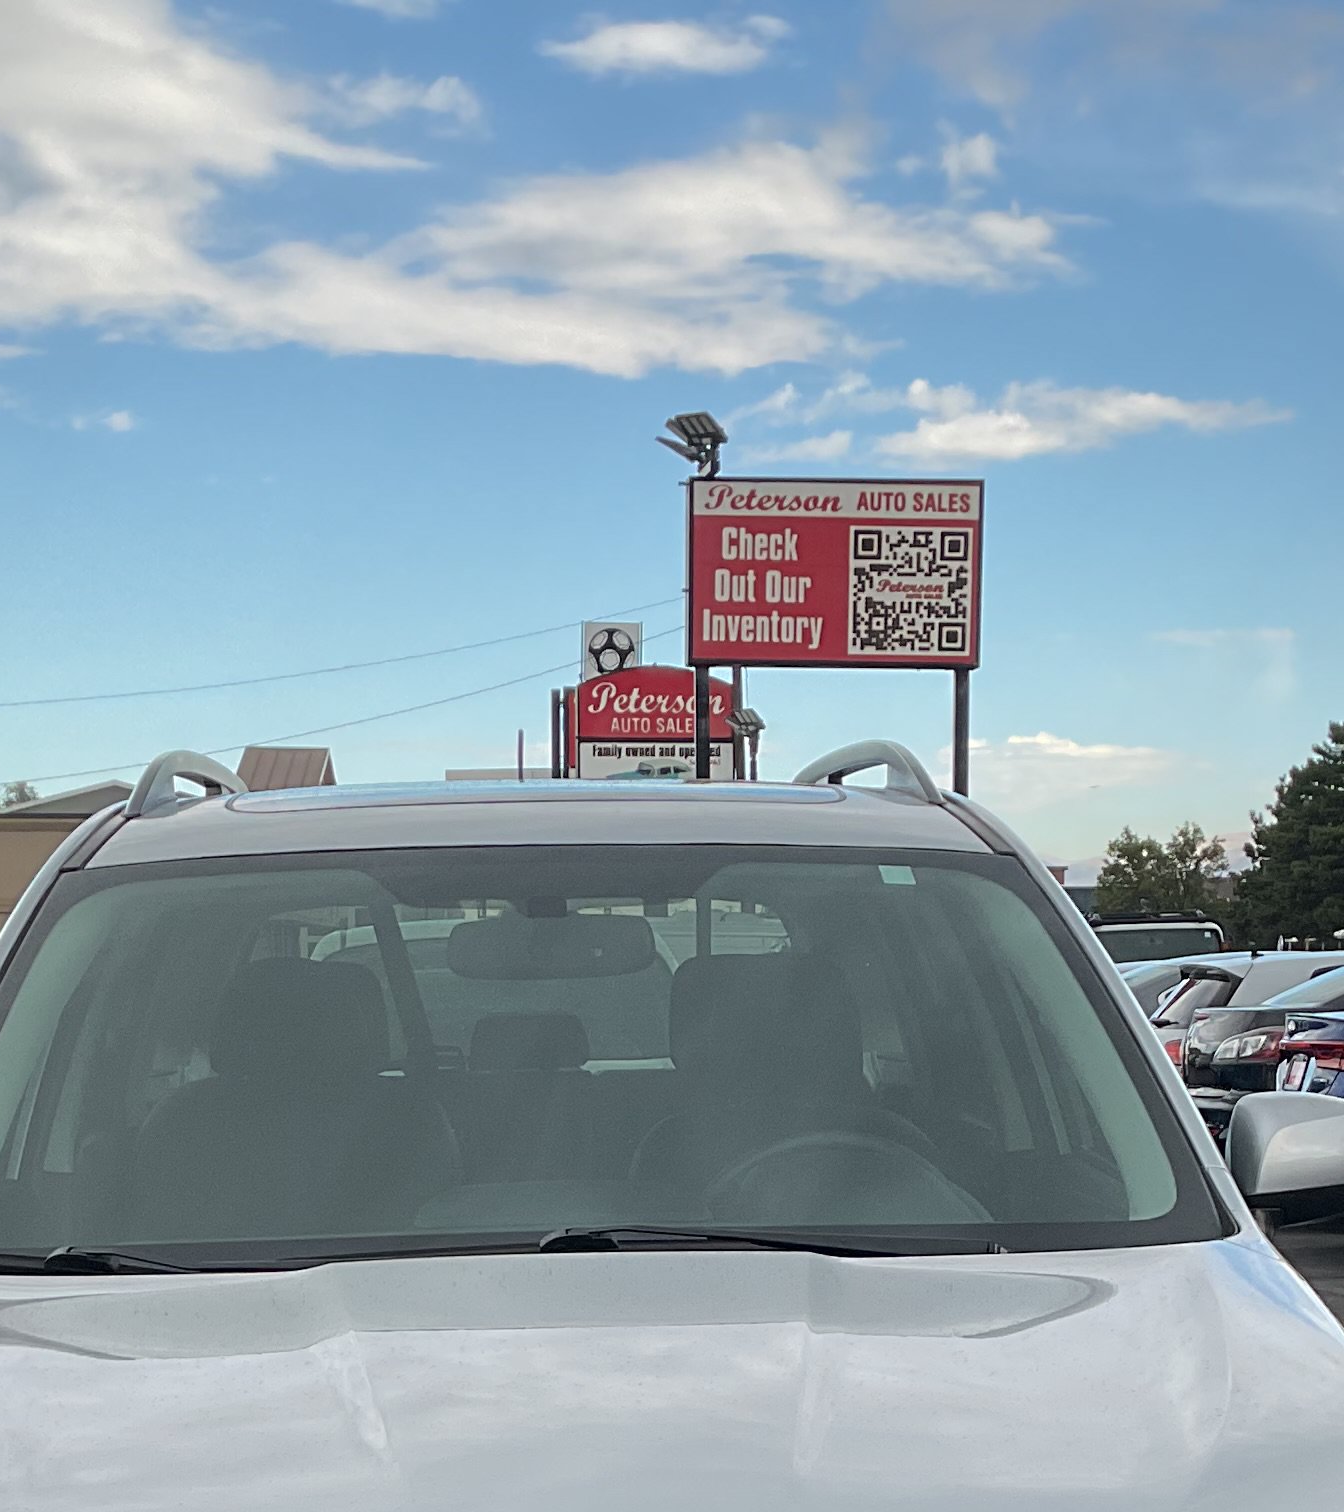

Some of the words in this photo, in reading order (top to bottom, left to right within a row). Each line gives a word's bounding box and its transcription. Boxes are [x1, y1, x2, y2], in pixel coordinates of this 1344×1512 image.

[705, 484, 843, 513] Peterson
[856, 492, 906, 513] AUTO
[912, 493, 971, 513] SALES
[721, 527, 799, 561] Check
[714, 569, 757, 602] Out
[765, 570, 813, 603] Our
[703, 609, 824, 649] Inventory
[611, 717, 651, 733] AUTO
[656, 717, 694, 733] SALE
[592, 745, 623, 759] Family
[625, 745, 656, 757] owned
[659, 745, 676, 757] and
